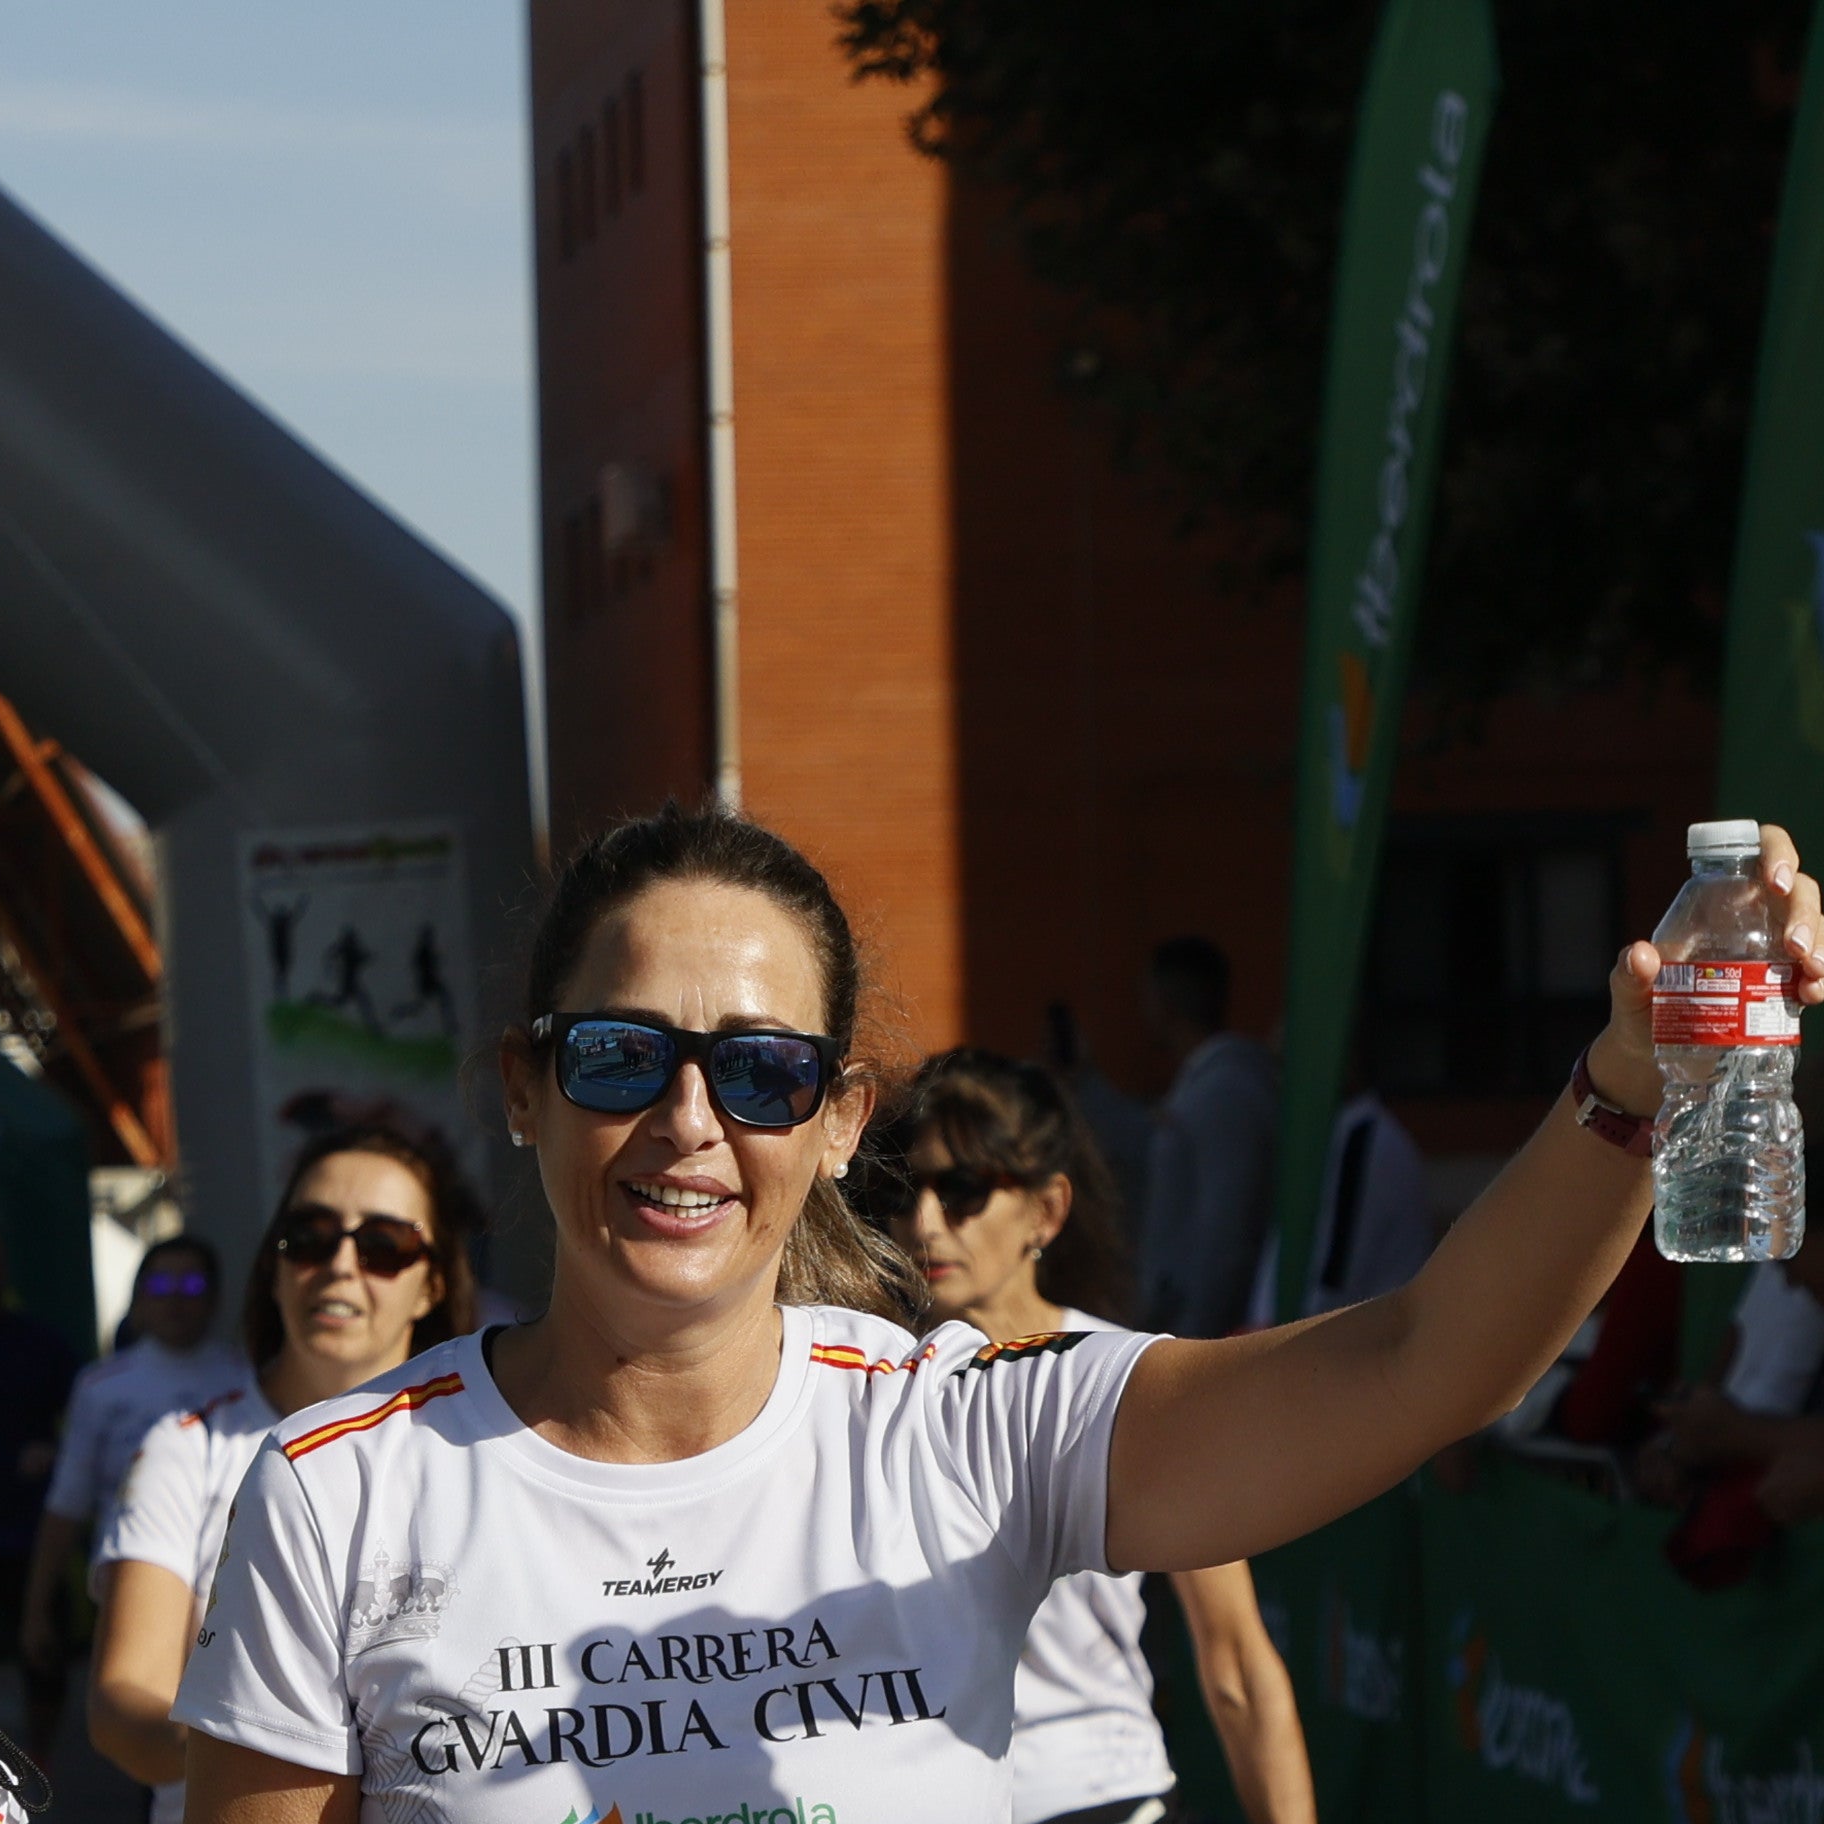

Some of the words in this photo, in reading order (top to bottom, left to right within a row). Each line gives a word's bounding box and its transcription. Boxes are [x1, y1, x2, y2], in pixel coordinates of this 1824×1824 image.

[1352, 88, 1469, 647] Iberdrola
[601, 1569, 724, 1597] TEAMERGY
[496, 1642, 559, 1693] III
[580, 1617, 841, 1686] CARRERA
[410, 1699, 730, 1775] GVARDIA
[753, 1667, 947, 1744] CIVIL
